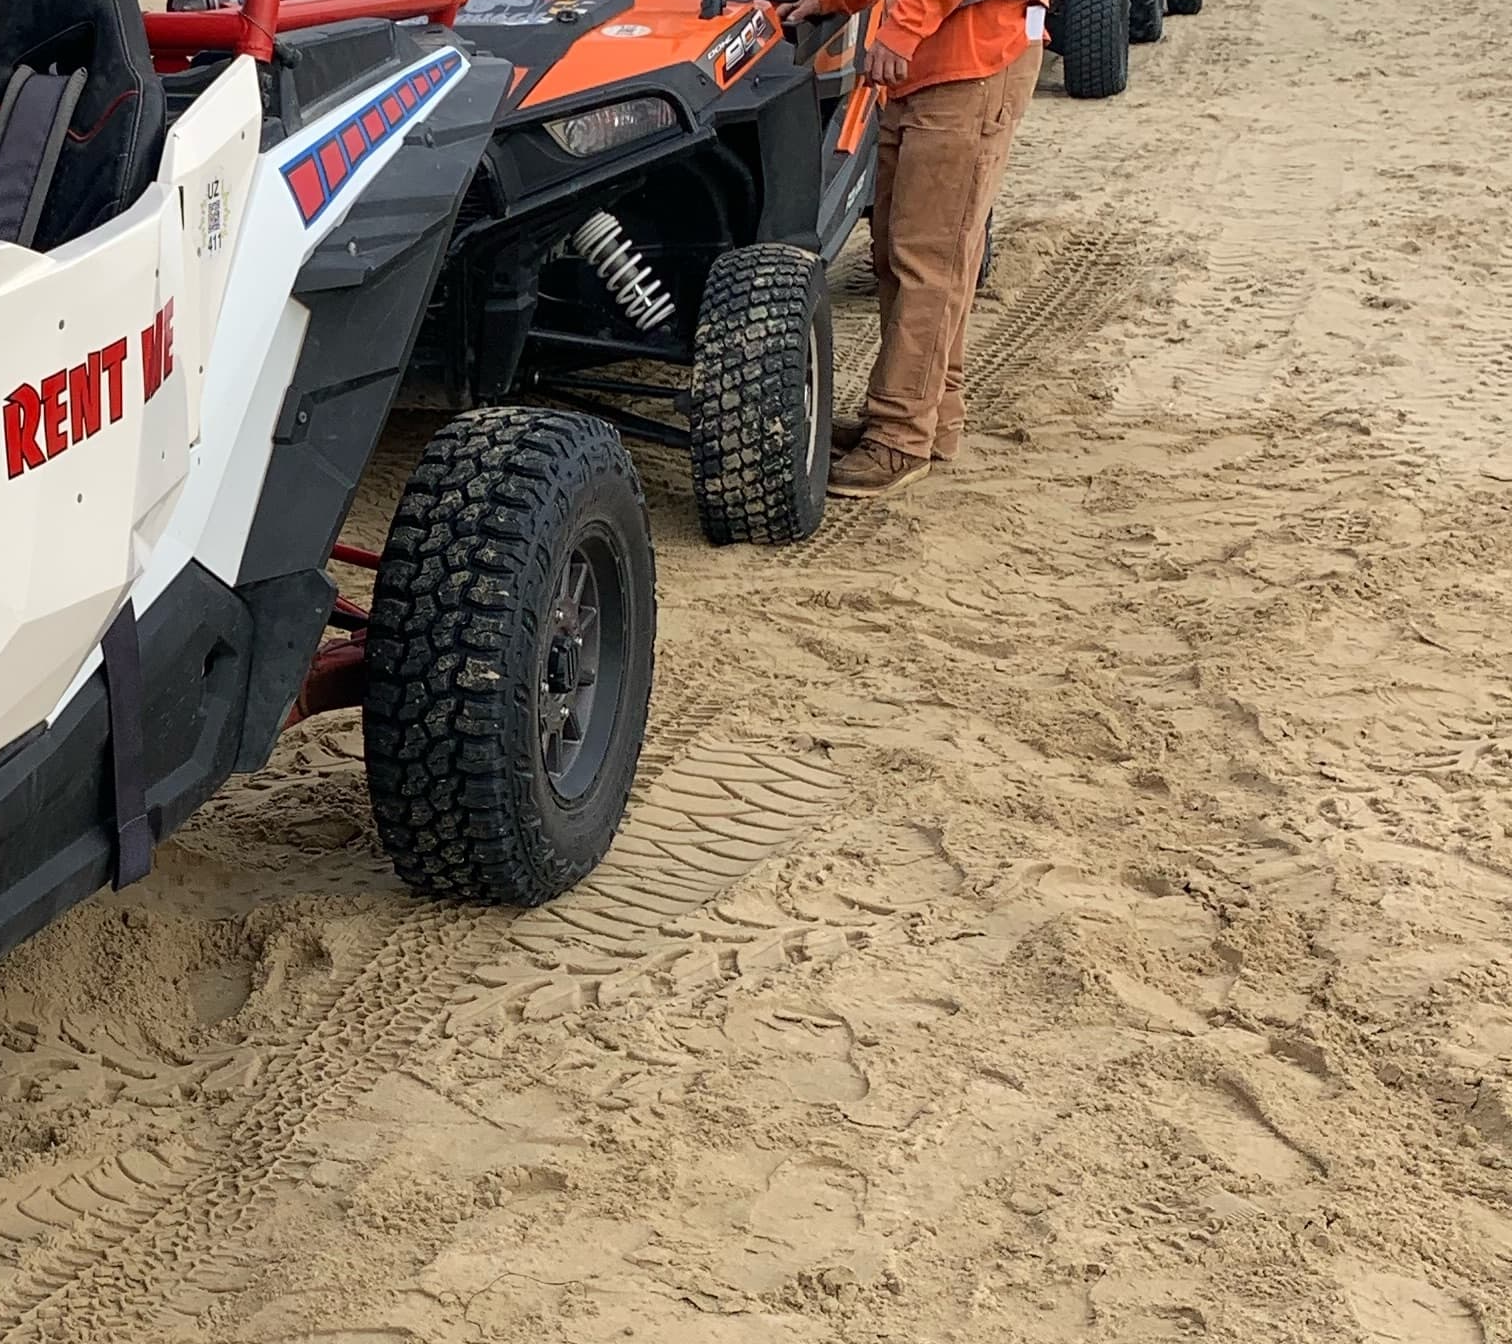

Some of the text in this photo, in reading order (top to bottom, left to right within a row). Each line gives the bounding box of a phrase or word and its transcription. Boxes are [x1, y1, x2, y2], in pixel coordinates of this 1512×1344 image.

[207, 179, 220, 200] UZ
[207, 232, 222, 251] 411
[2, 295, 177, 481] RENT ME
